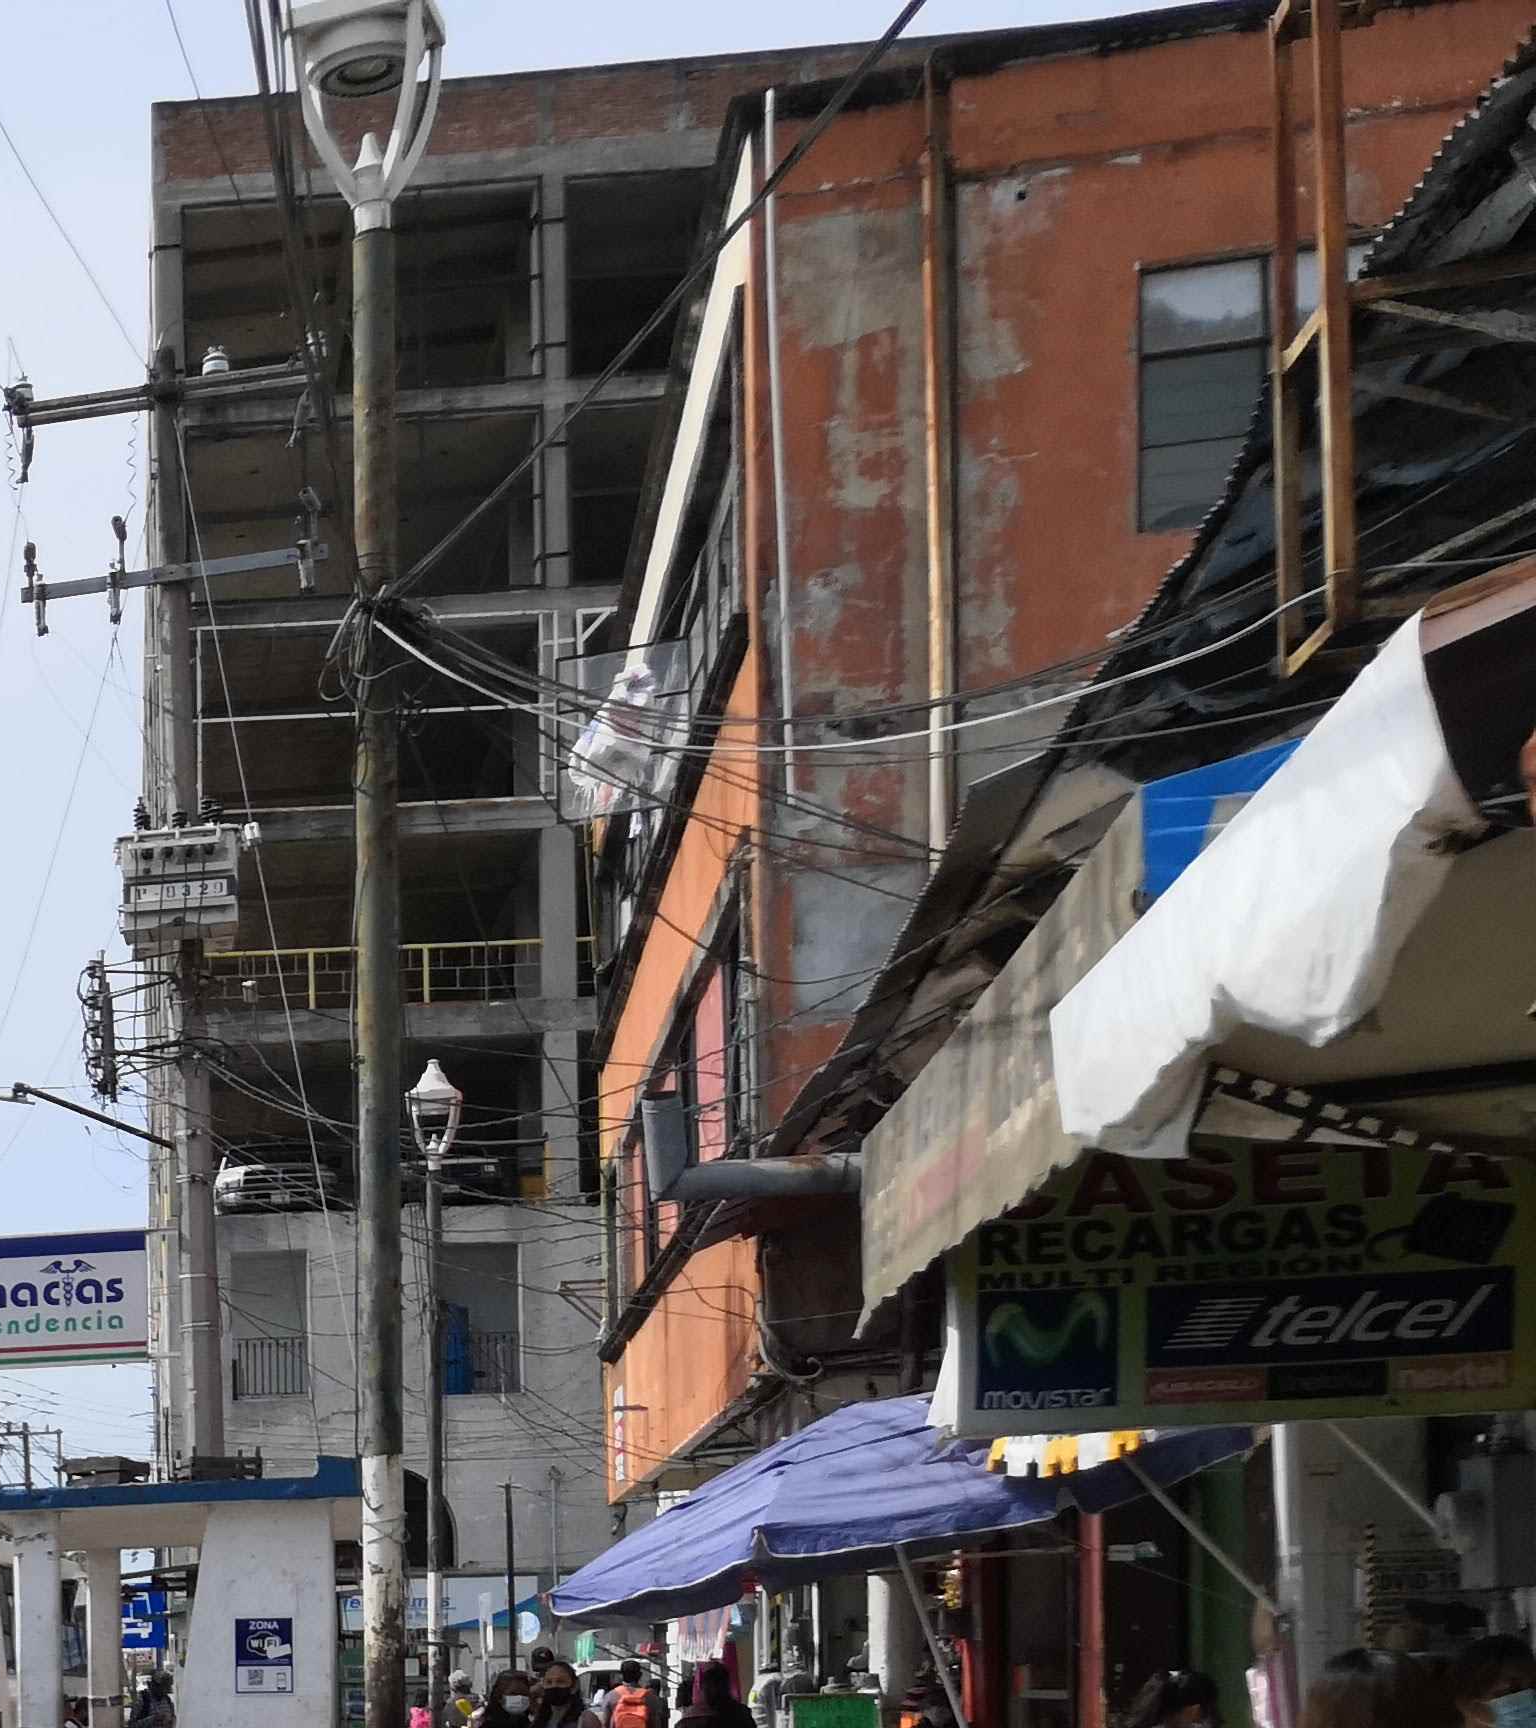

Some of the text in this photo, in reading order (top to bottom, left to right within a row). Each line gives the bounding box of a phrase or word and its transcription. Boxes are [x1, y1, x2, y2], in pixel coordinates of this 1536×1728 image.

[979, 1204, 1367, 1267] RECARGAS
[977, 1265, 1134, 1291] MULTI
[1249, 1284, 1498, 1350] telcel
[983, 1386, 1112, 1410] movistar
[249, 1620, 279, 1630] ZONA
